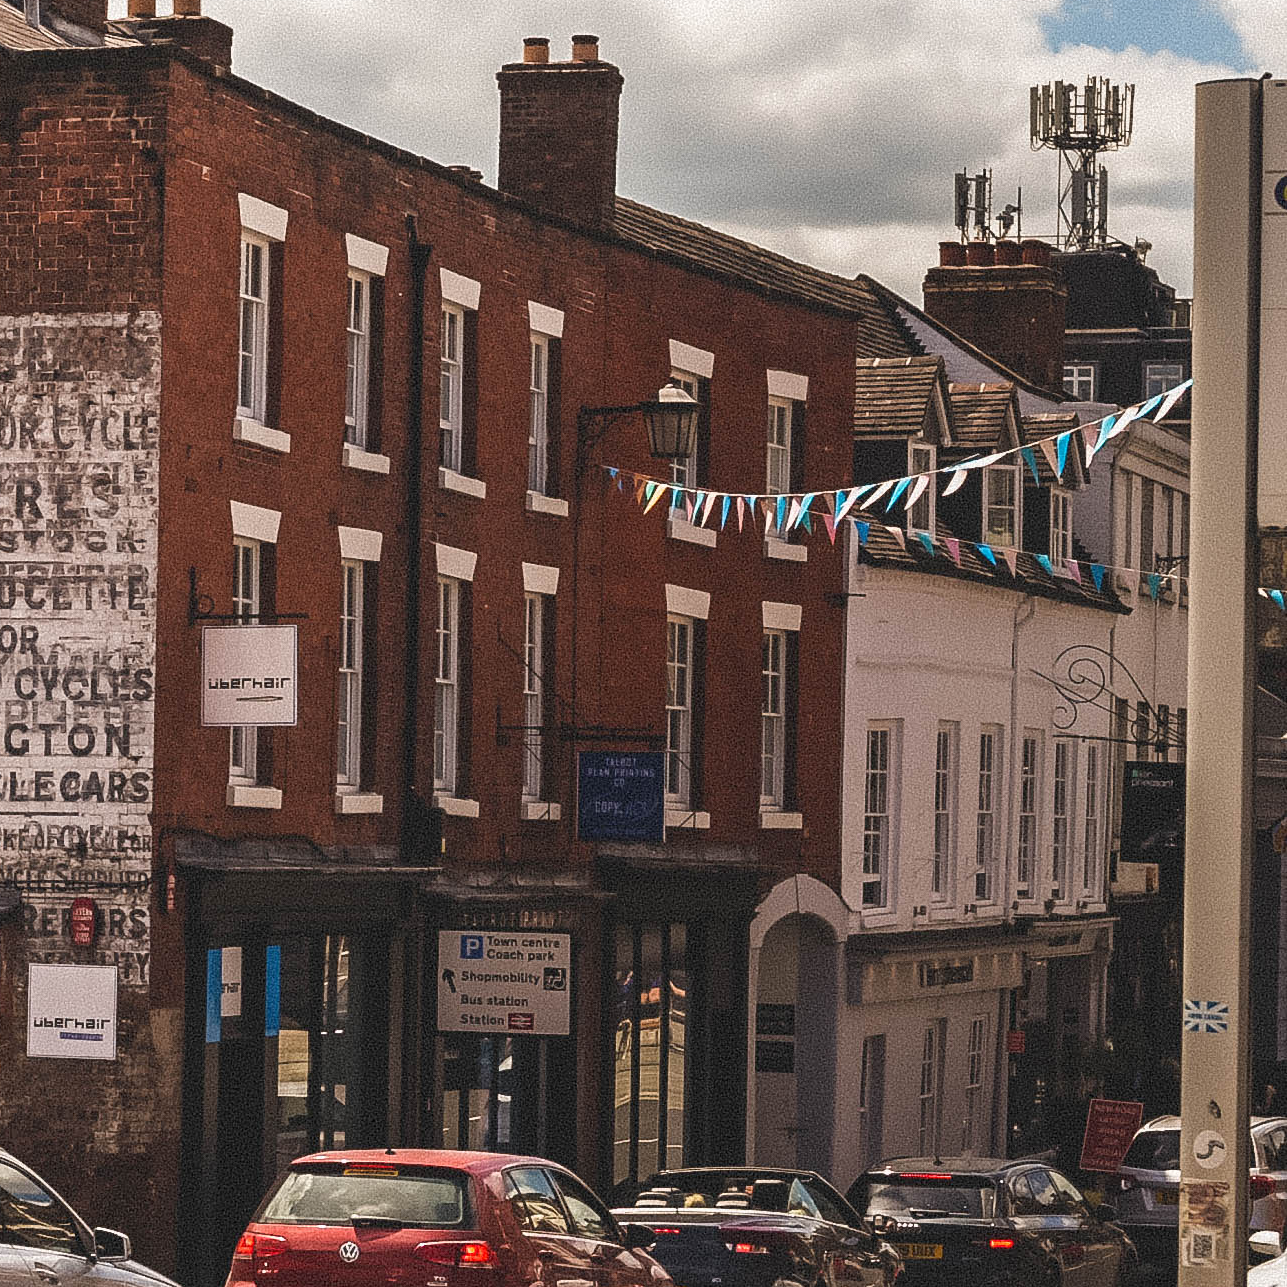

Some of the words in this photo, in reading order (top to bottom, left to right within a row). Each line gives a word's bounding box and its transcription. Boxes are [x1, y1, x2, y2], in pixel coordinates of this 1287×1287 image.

[14, 668, 153, 701] CYCLES
[487, 935, 517, 947] Town
[522, 937, 560, 949] centre
[487, 949, 524, 961] Coach
[528, 950, 555, 962] park
[461, 970, 540, 986] Shopmobility
[460, 994, 483, 1005] Bus
[487, 995, 529, 1007] station
[460, 1014, 505, 1026] Station
